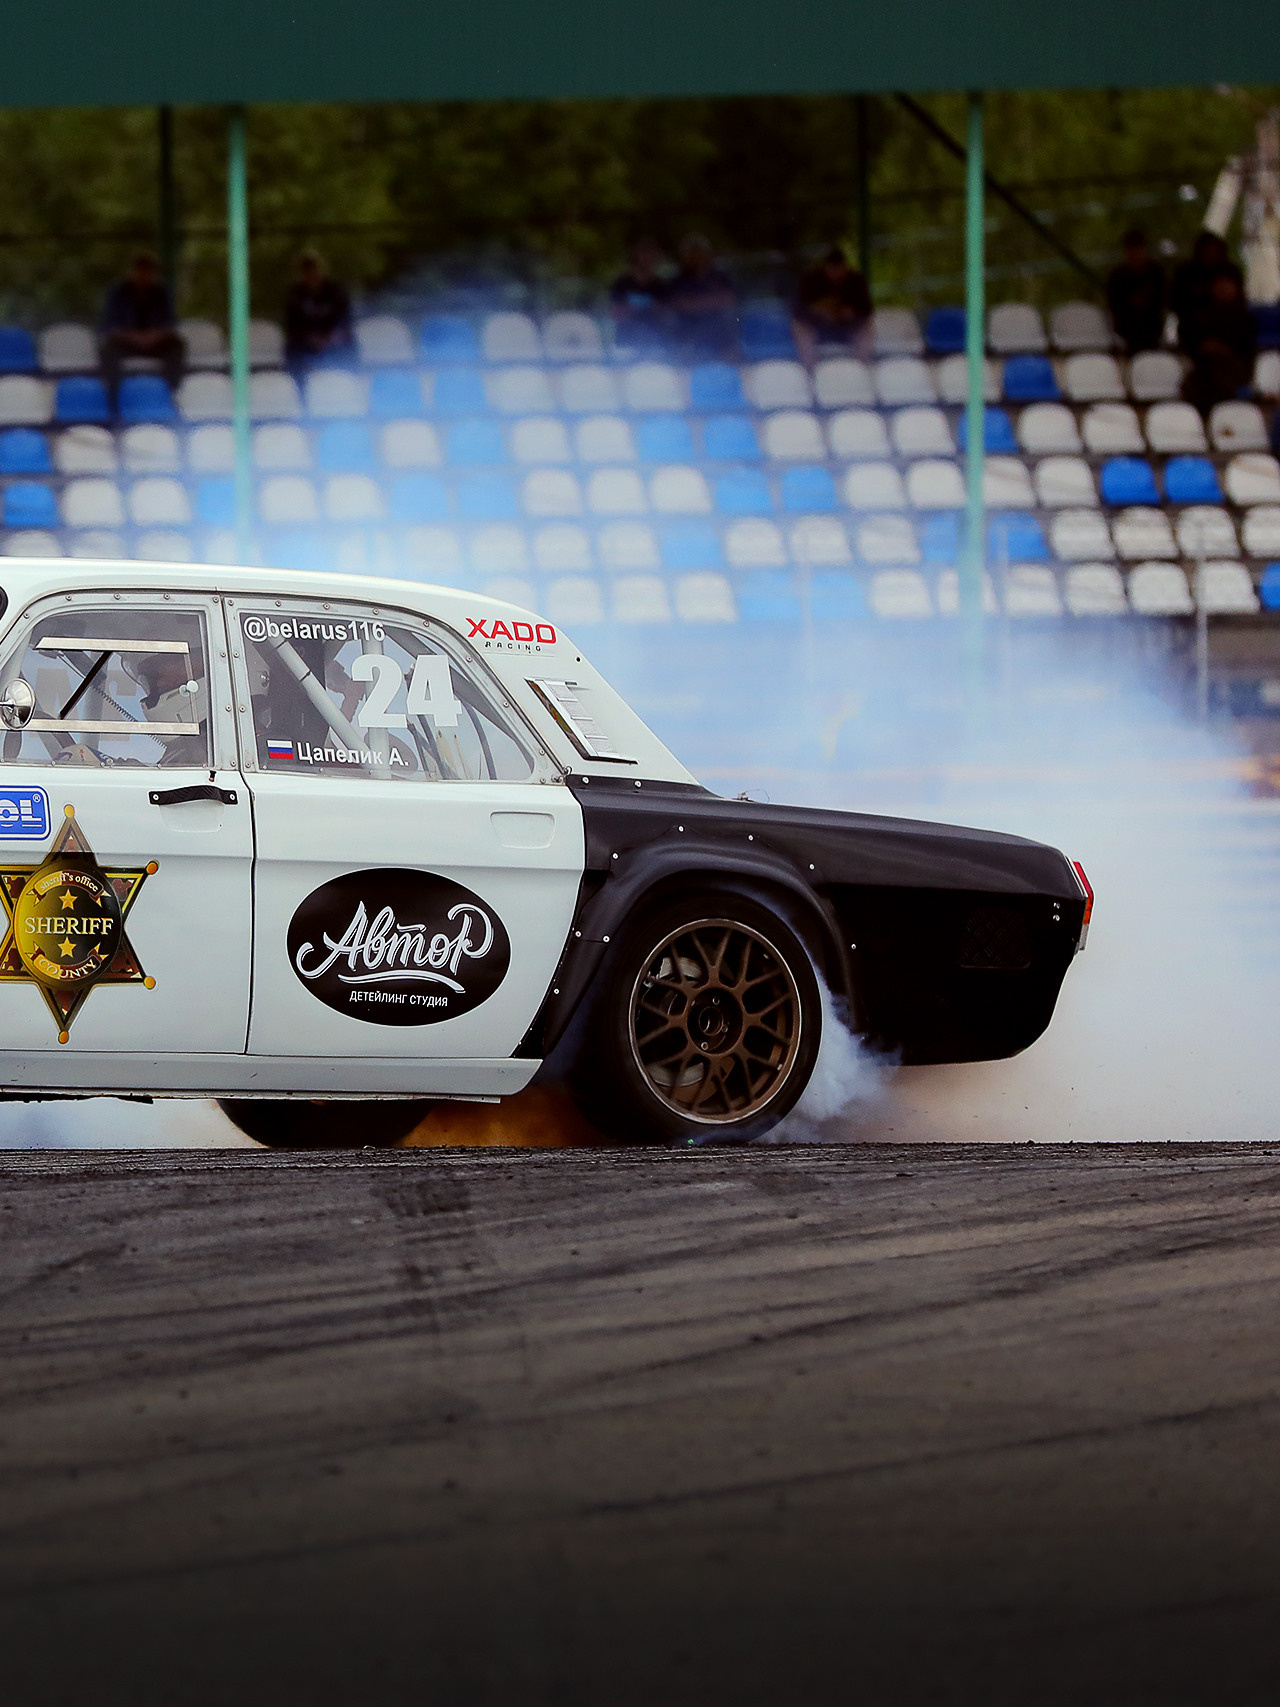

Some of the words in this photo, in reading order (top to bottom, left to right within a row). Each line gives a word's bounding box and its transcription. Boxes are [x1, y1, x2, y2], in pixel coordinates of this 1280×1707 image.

[243, 616, 387, 643] @belarus116
[465, 617, 557, 645] XADO
[484, 641, 542, 652] RACING
[351, 653, 463, 729] 24
[297, 742, 383, 765] Цапелик
[75, 875, 99, 893] office
[24, 916, 114, 935] SHERIFF
[38, 958, 98, 979] COUNTY
[349, 989, 408, 1005] ДЕТЕЙЛИНГ
[409, 994, 448, 1008] СТУДИЯ
